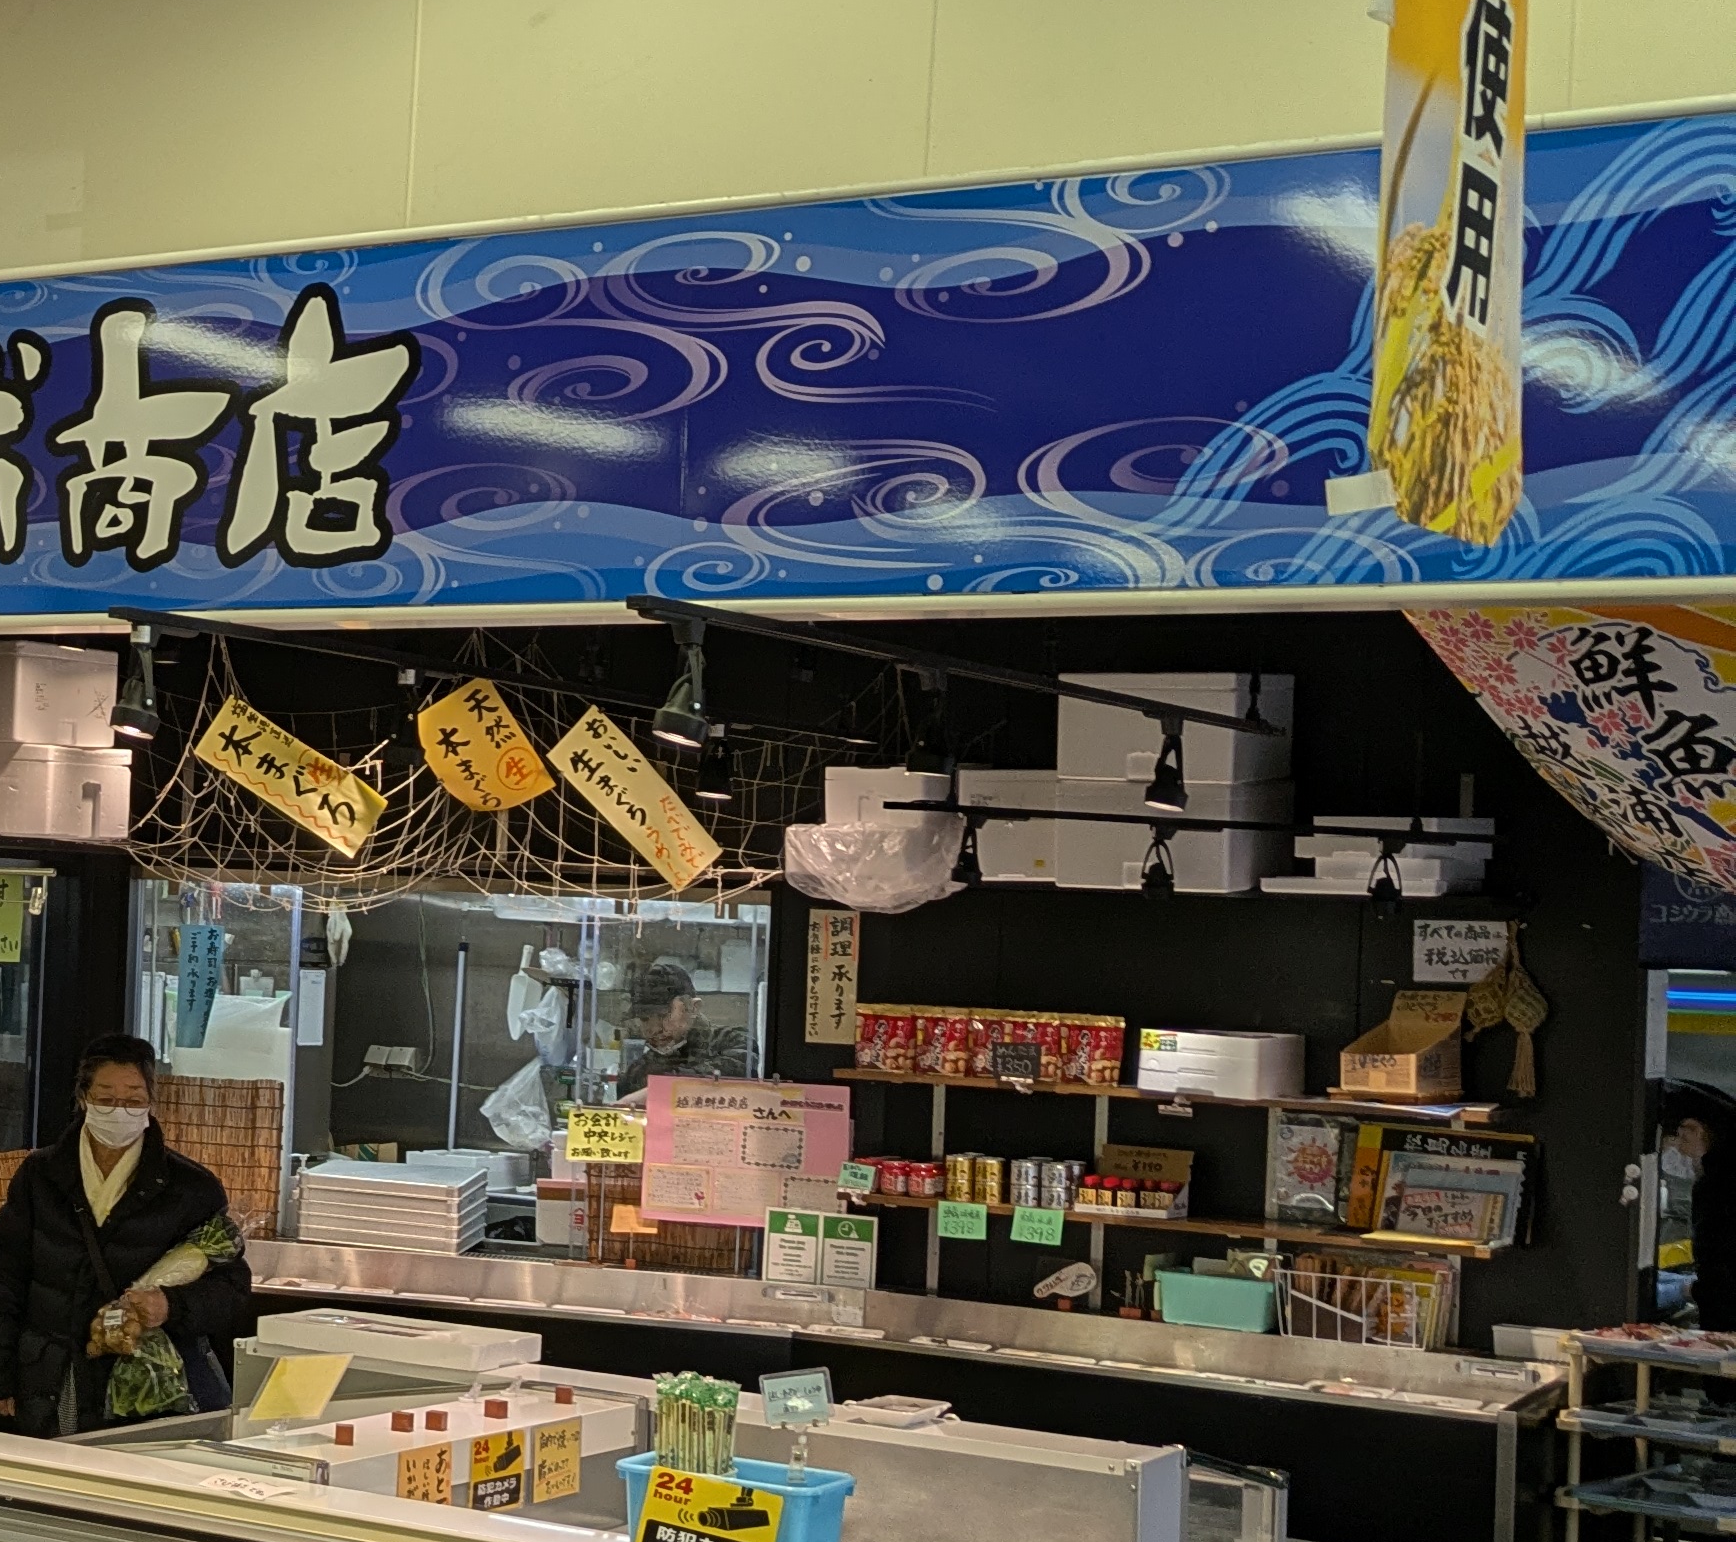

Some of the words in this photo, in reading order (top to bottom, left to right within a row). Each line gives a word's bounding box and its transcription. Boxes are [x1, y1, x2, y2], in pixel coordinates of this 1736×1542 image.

[464, 689, 516, 749] 天然
[585, 718, 642, 774] おいしい
[218, 725, 357, 828] 本まぐろ
[436, 727, 502, 809] 本まぐろ
[569, 749, 648, 827] 生まぐろ
[473, 1438, 490, 1456] 24
[653, 1489, 692, 1506] hour
[655, 1472, 694, 1496] 24
